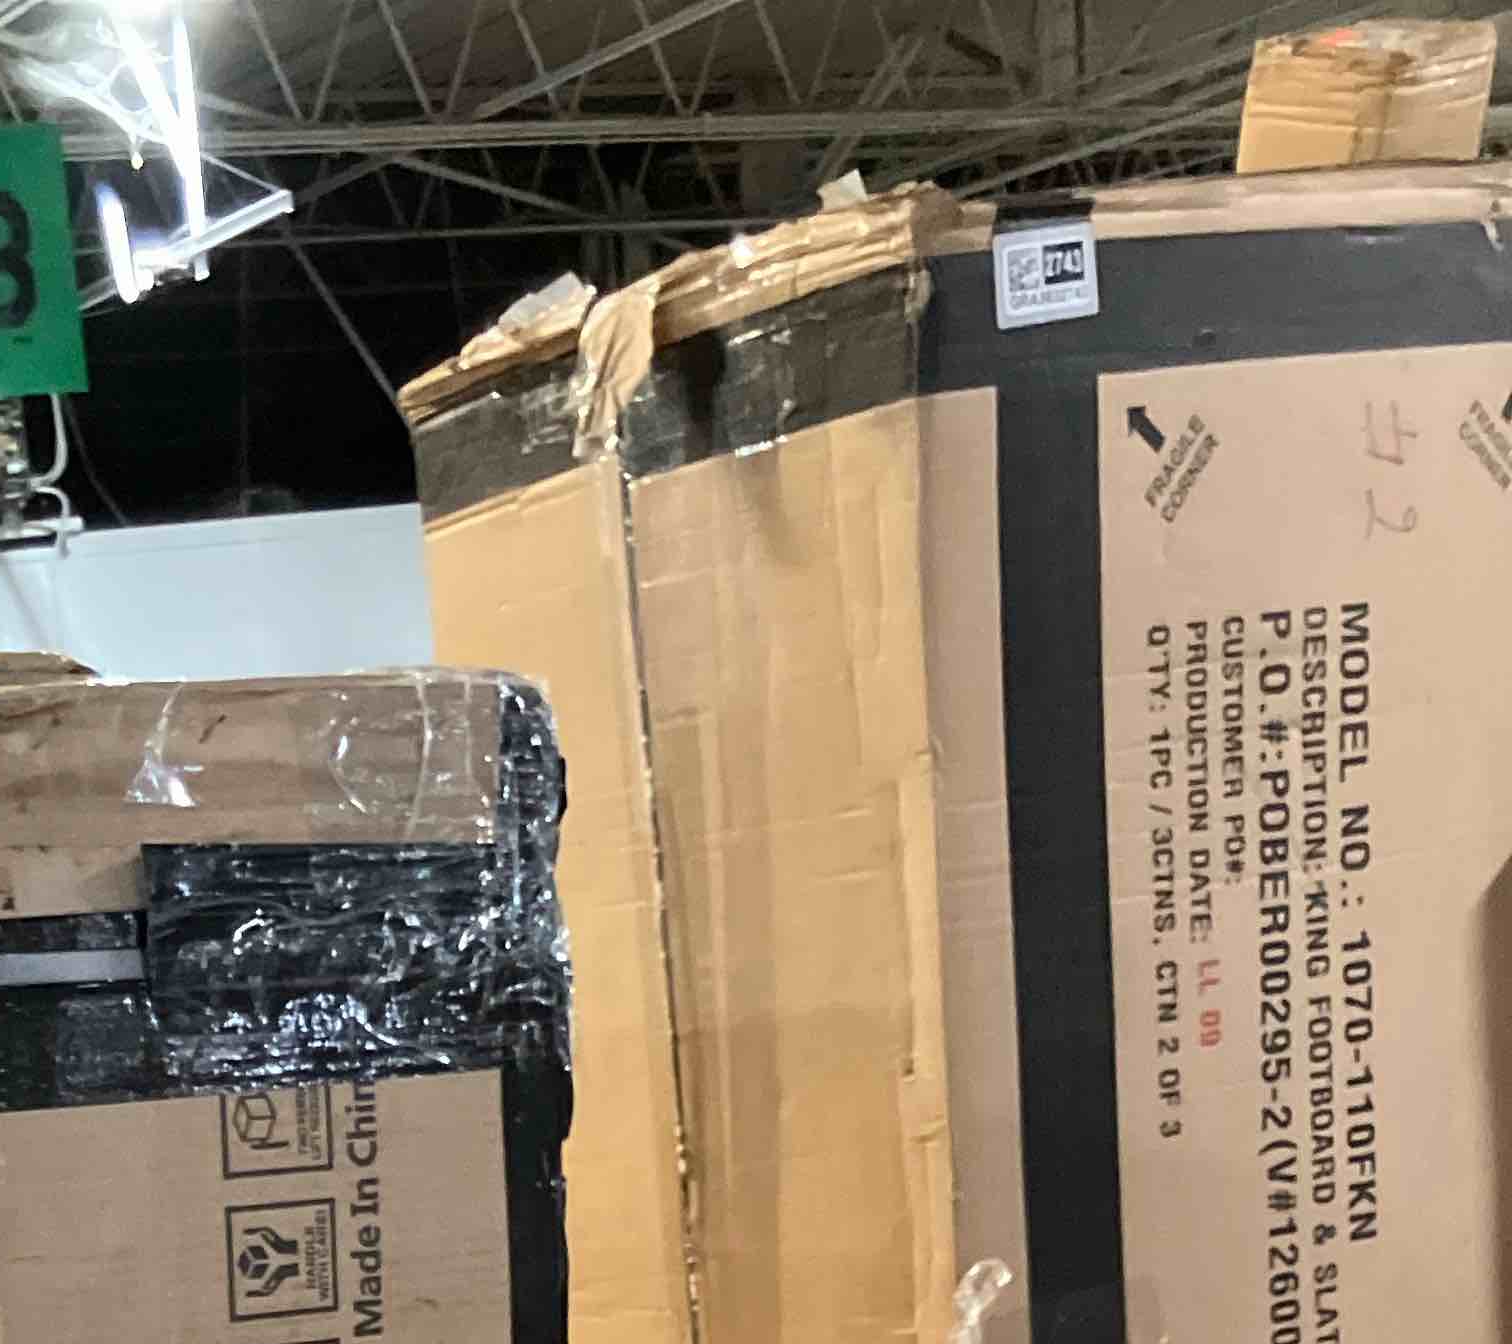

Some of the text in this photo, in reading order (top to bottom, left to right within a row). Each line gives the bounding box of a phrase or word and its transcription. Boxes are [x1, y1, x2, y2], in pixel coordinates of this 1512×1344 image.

[1185, 620, 1209, 832] PRODUCTION
[1221, 615, 1245, 799] CUSTOMER
[1338, 601, 1370, 783] MODEL
[1189, 848, 1214, 944] DATE:
[1155, 960, 1179, 1025] CTN
[1157, 1036, 1180, 1055] 2
[1157, 1068, 1181, 1107] OF
[1307, 995, 1336, 1205] FOOTBOARD
[344, 1078, 384, 1338] Made In Chin
[1312, 1223, 1338, 1246] &
